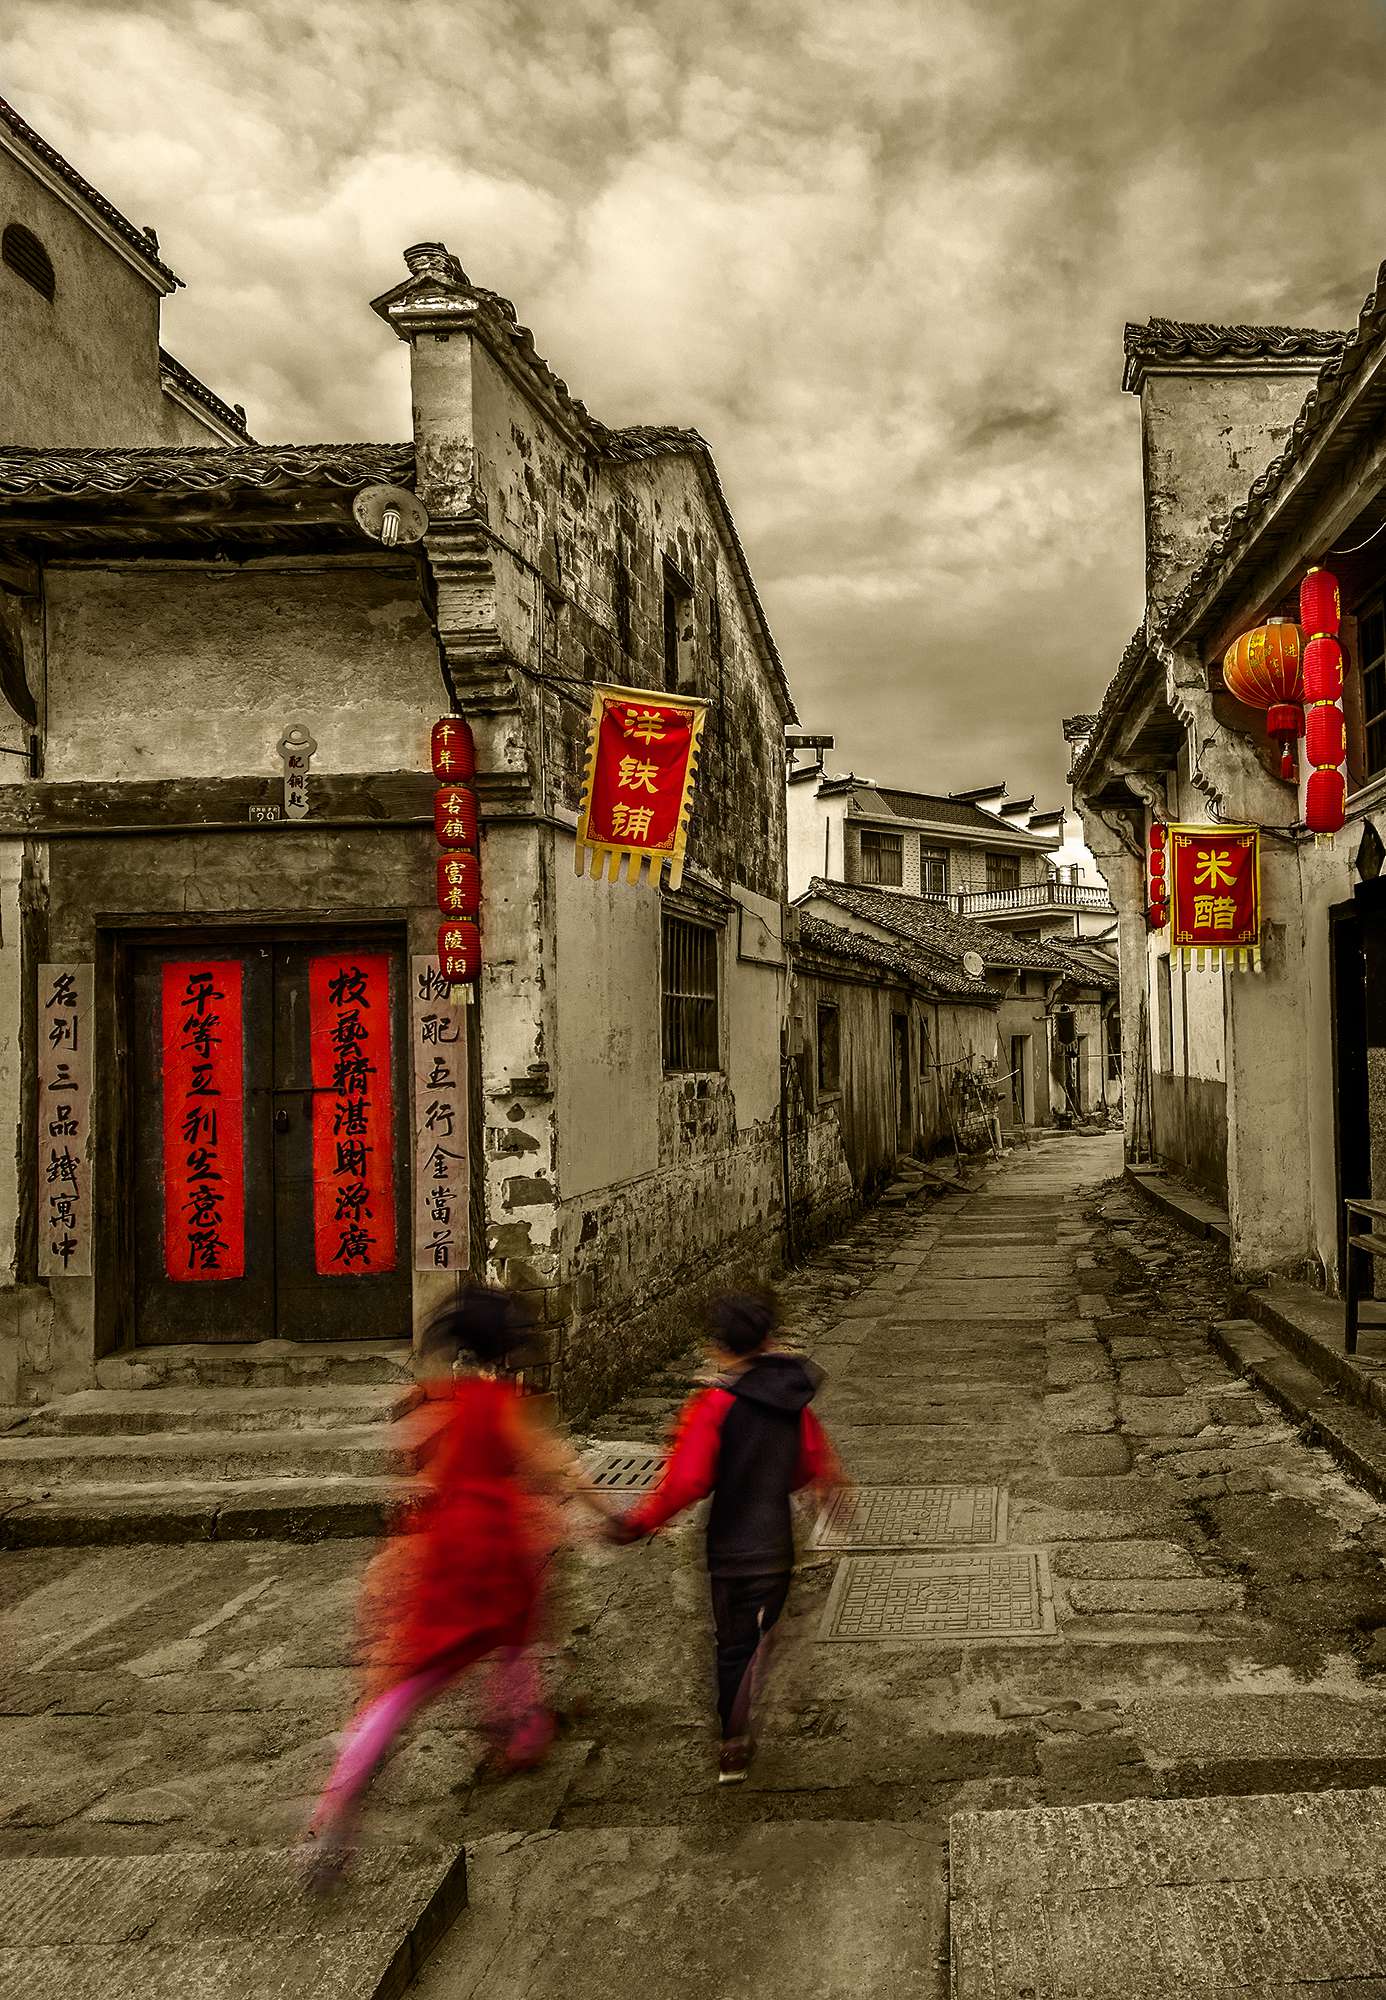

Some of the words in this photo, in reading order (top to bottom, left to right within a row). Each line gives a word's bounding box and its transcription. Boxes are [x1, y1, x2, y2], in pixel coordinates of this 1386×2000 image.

[256, 812, 275, 823] 29
[611, 708, 666, 842] 洋铁铺
[1193, 849, 1238, 931] 米醋
[180, 974, 230, 1270] 平等互利生意隆
